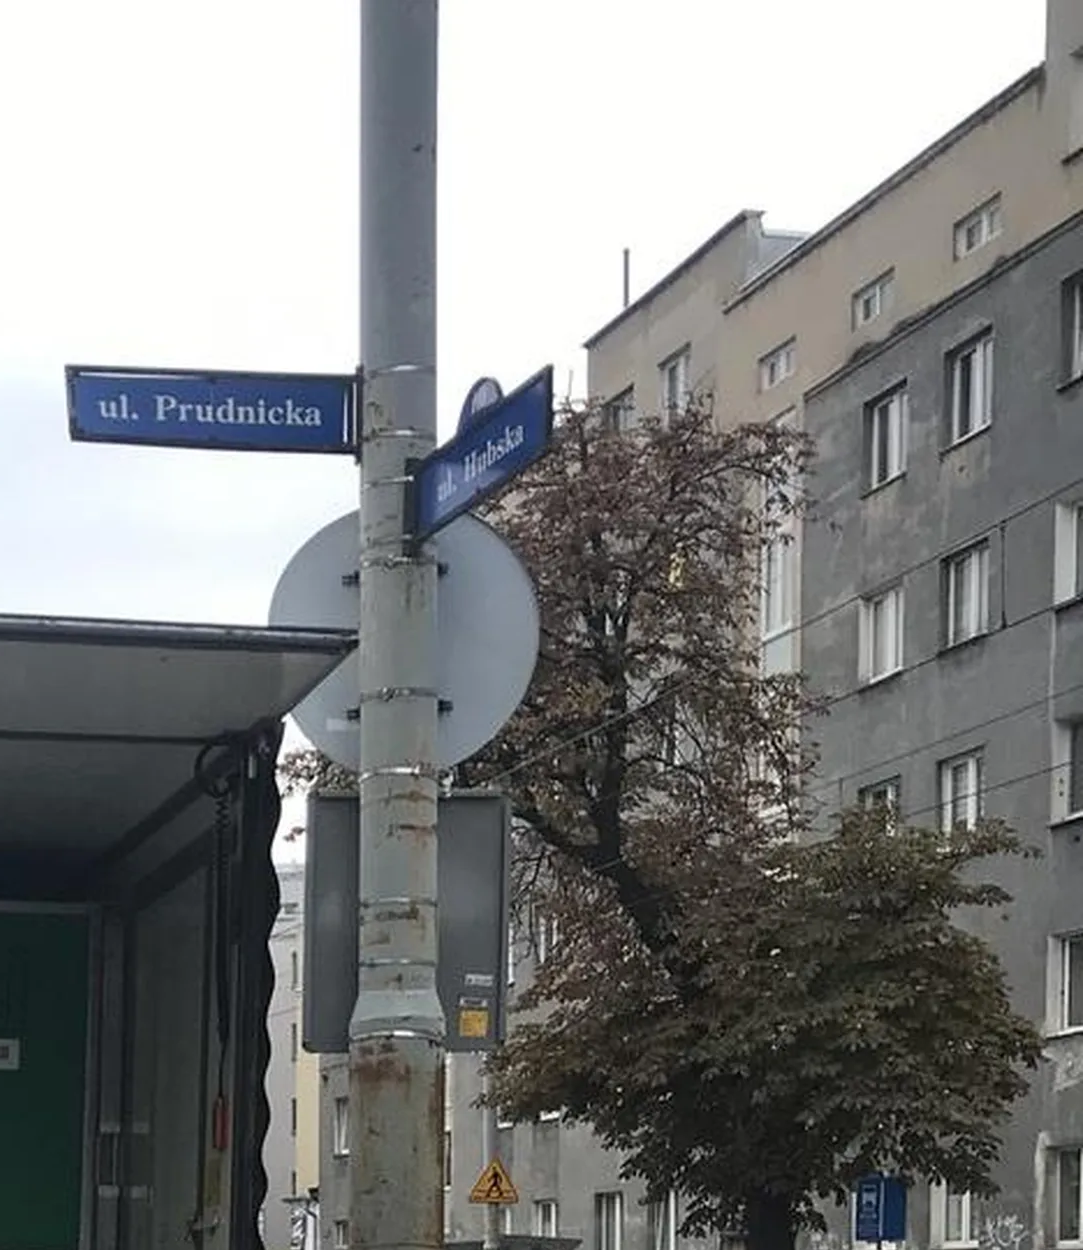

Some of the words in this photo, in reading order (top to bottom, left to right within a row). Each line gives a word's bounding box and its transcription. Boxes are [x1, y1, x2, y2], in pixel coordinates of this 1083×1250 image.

[99, 396, 139, 422] ul.
[155, 395, 323, 427] Prudnicka
[437, 465, 457, 502] ul.
[464, 425, 524, 483] Hubska
